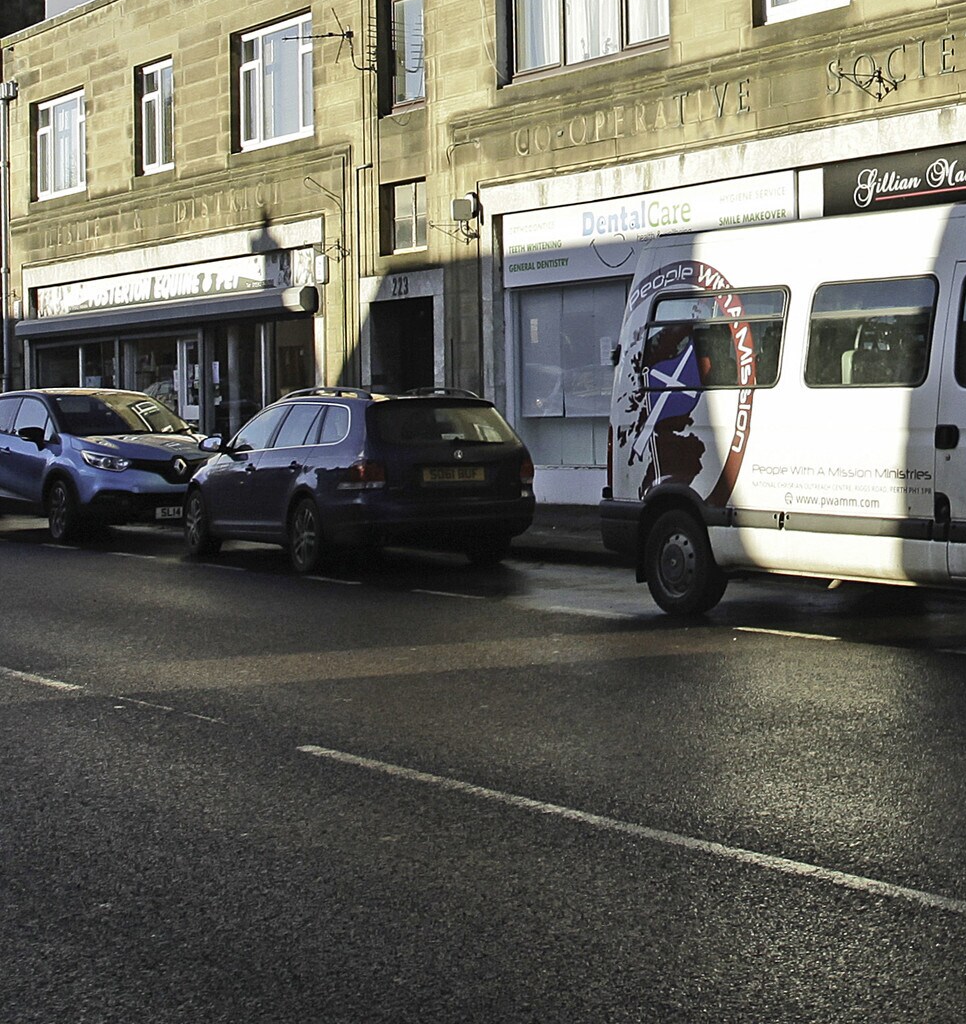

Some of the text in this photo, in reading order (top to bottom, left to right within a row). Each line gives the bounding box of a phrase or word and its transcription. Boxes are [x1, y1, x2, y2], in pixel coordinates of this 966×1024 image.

[719, 187, 786, 204] HYGIENE SERVICE
[853, 168, 922, 208] Gillian
[582, 200, 692, 236] DentalCare
[719, 209, 787, 226] SMILE MAKEOVER
[508, 240, 562, 255] TEETH WHITENING
[509, 257, 570, 273] GENERAL DENTISTRY
[392, 276, 409, 296] 223
[627, 264, 694, 312] People
[751, 463, 932, 480] People With A Mission Ministries
[795, 495, 880, 509] www.pwamm.com
[161, 507, 181, 517] SL14
